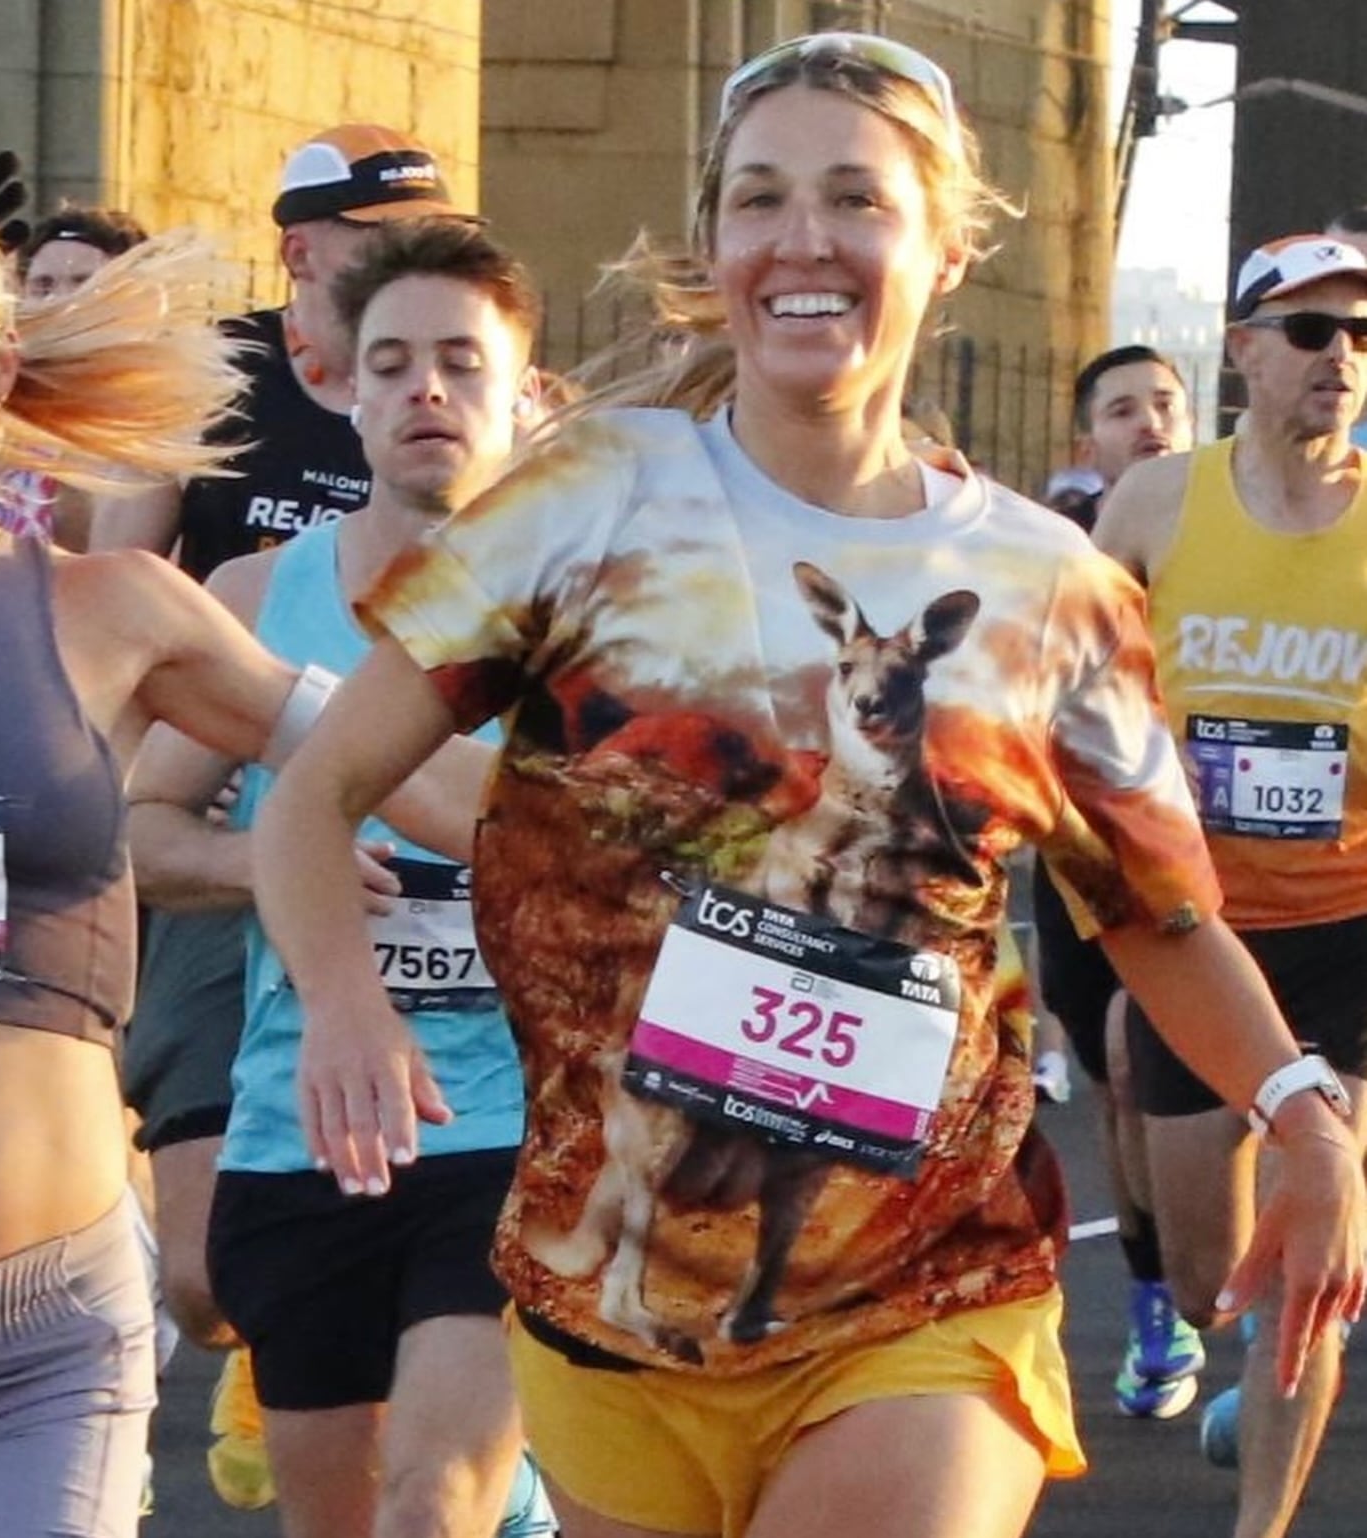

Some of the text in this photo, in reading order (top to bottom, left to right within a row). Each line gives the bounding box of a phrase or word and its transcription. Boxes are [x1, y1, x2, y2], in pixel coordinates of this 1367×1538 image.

[1212, 786, 1229, 809] A
[1254, 785, 1324, 814] 1032
[697, 889, 754, 937] tcs
[762, 908, 797, 928] TATA
[753, 933, 805, 958] SERVICES
[757, 921, 837, 953] CONSULTANCY
[374, 943, 476, 980] 7567
[900, 979, 942, 1004] TATA
[741, 986, 863, 1068] 325
